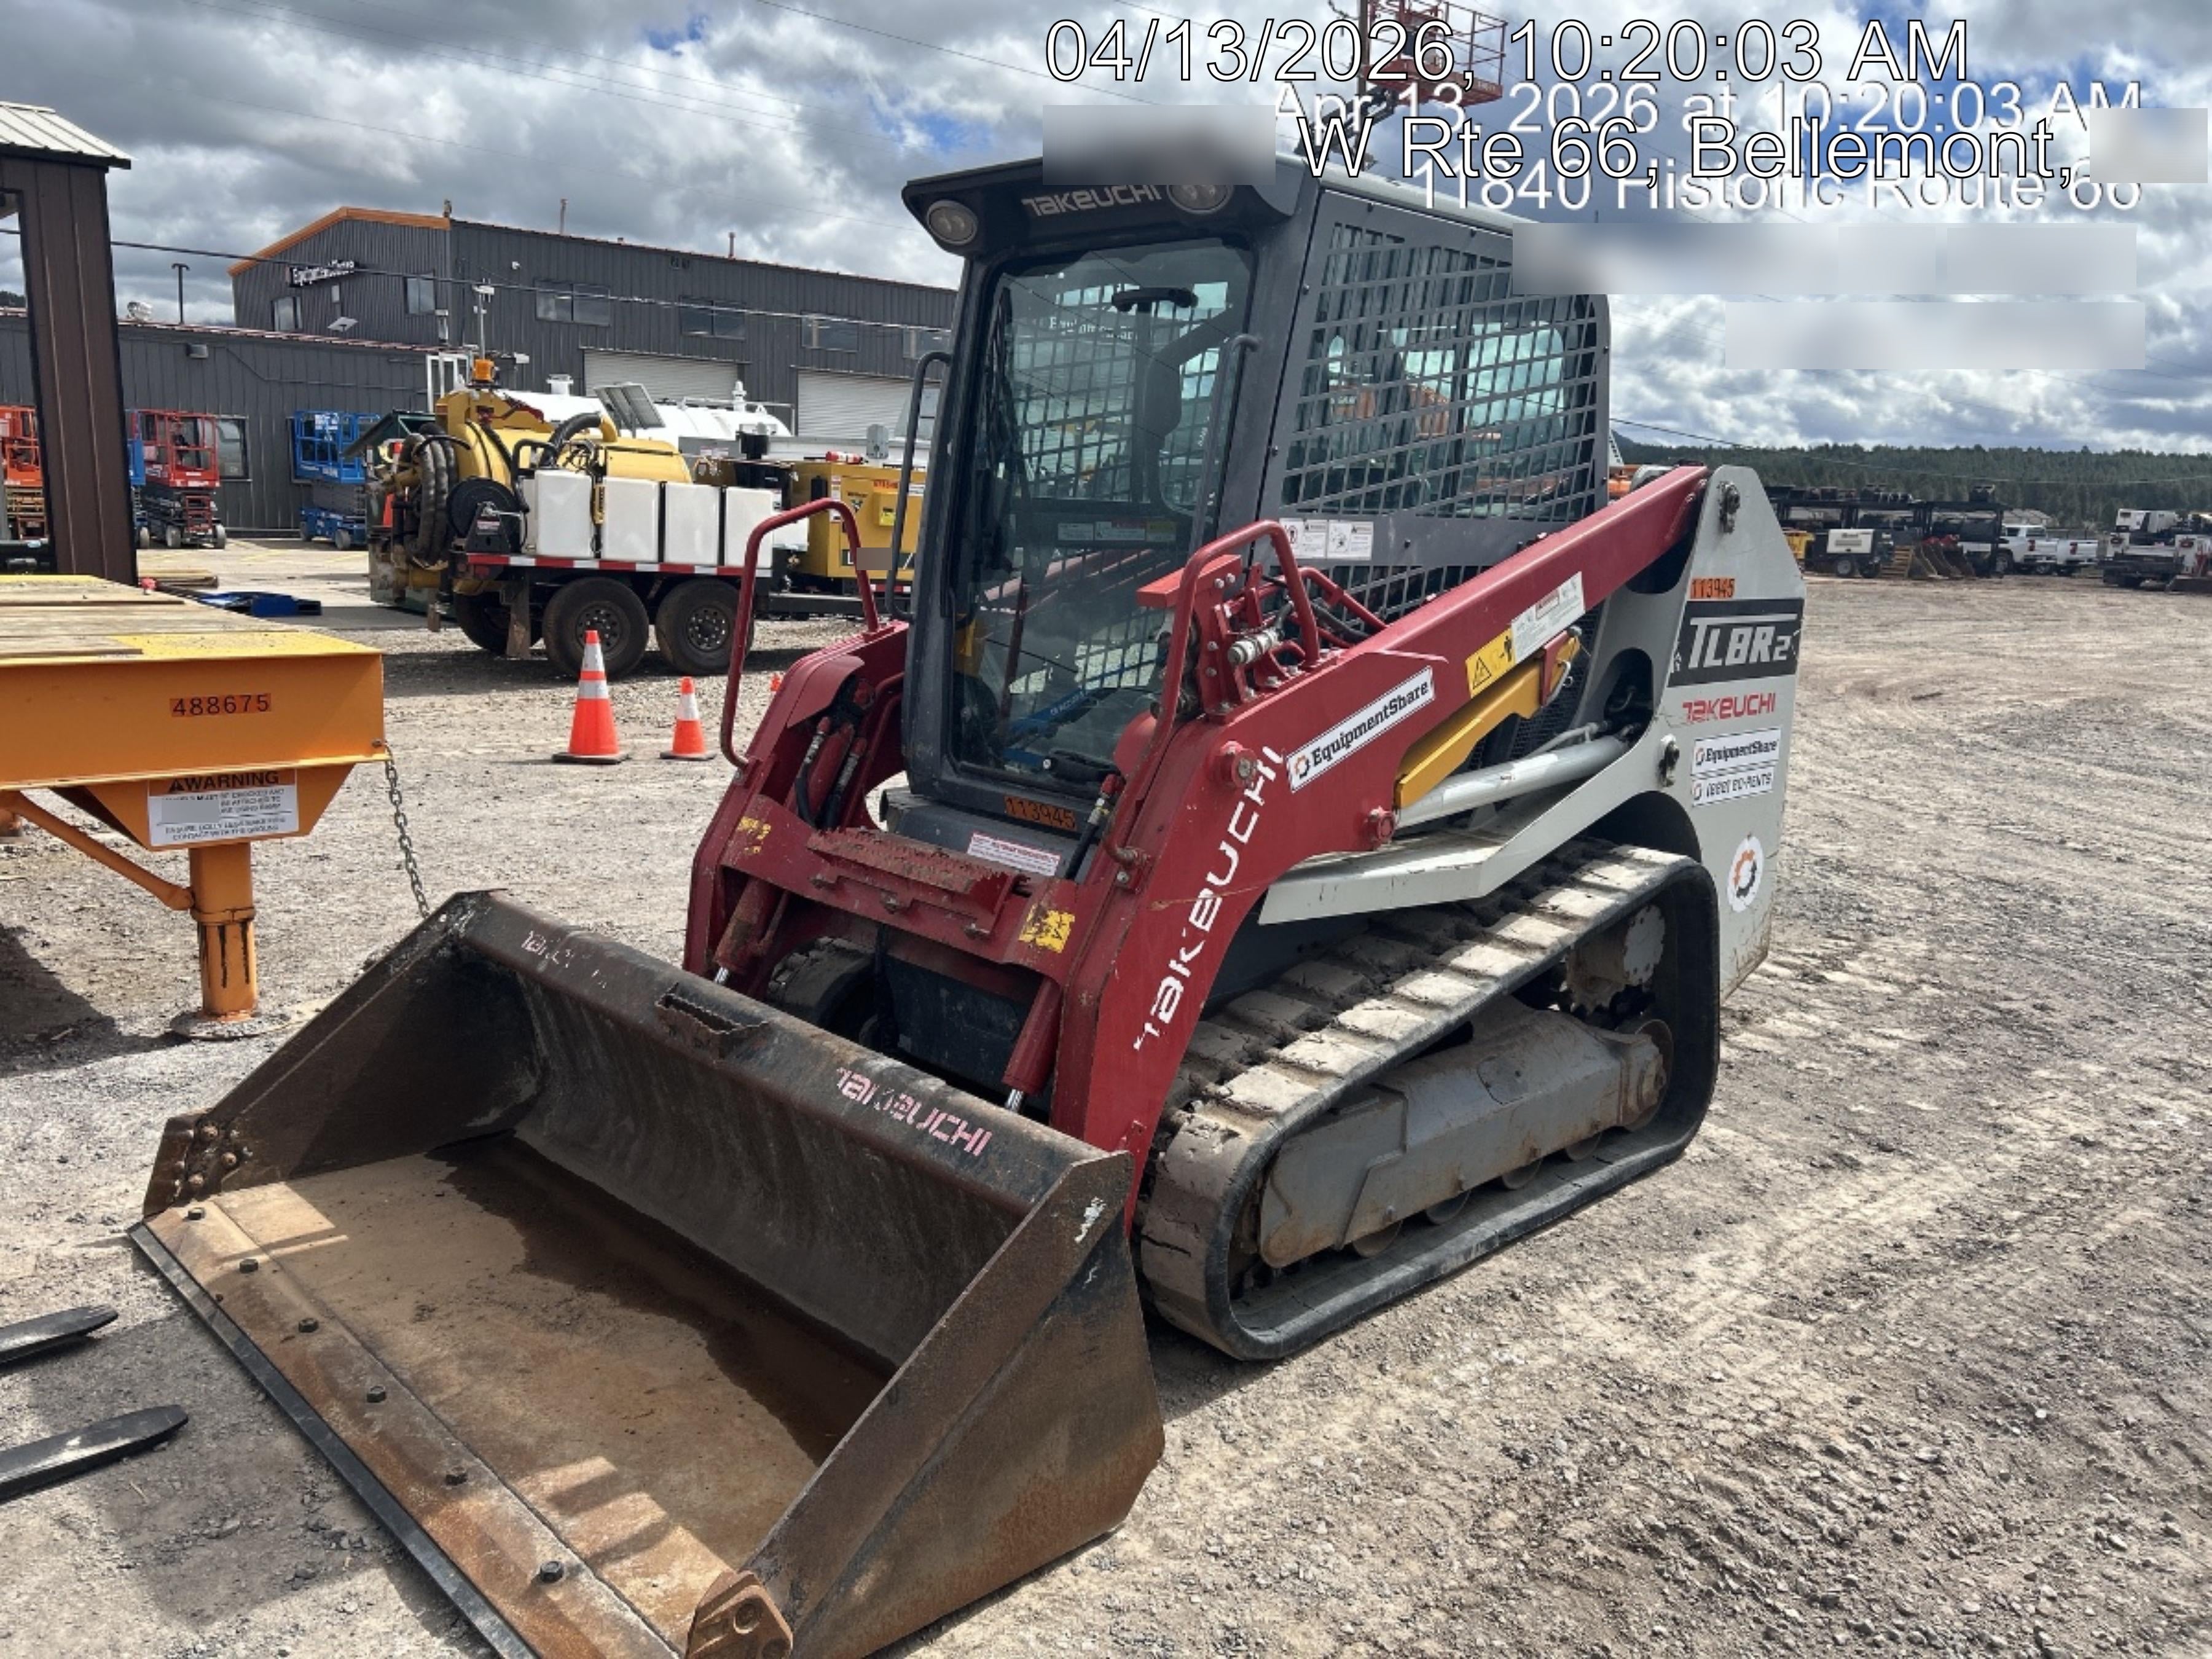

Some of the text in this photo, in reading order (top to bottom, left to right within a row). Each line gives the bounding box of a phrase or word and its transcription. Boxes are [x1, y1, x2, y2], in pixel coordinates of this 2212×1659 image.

[173, 694, 270, 716] 488675
[1682, 692, 1776, 723] TAKEUCHI
[1311, 681, 1429, 767] EquipmentShare
[1705, 740, 1778, 764] EquipmentShare
[184, 771, 280, 791] WARNING
[1006, 798, 1076, 828] 113945
